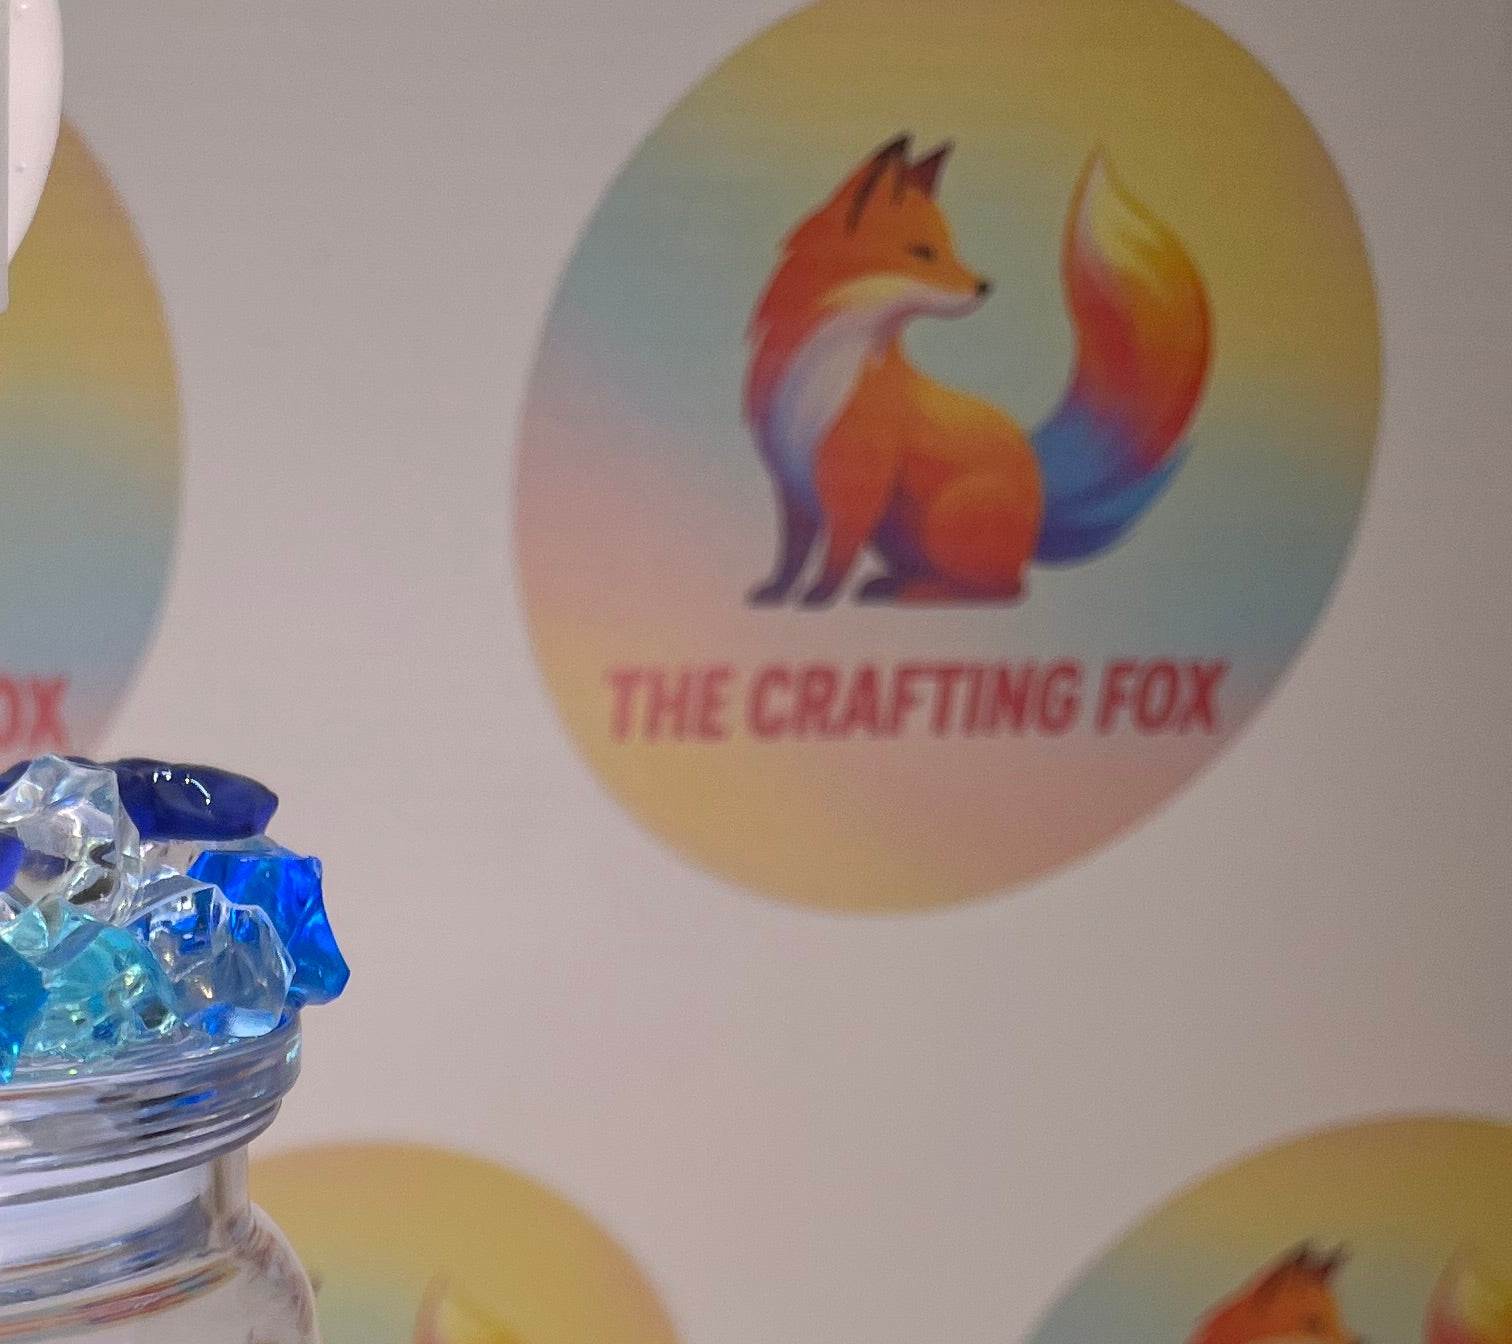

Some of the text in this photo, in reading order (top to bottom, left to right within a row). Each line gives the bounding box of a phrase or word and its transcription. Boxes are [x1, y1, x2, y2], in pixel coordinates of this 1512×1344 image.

[604, 658, 1228, 743] THE CRAFTING FOX
